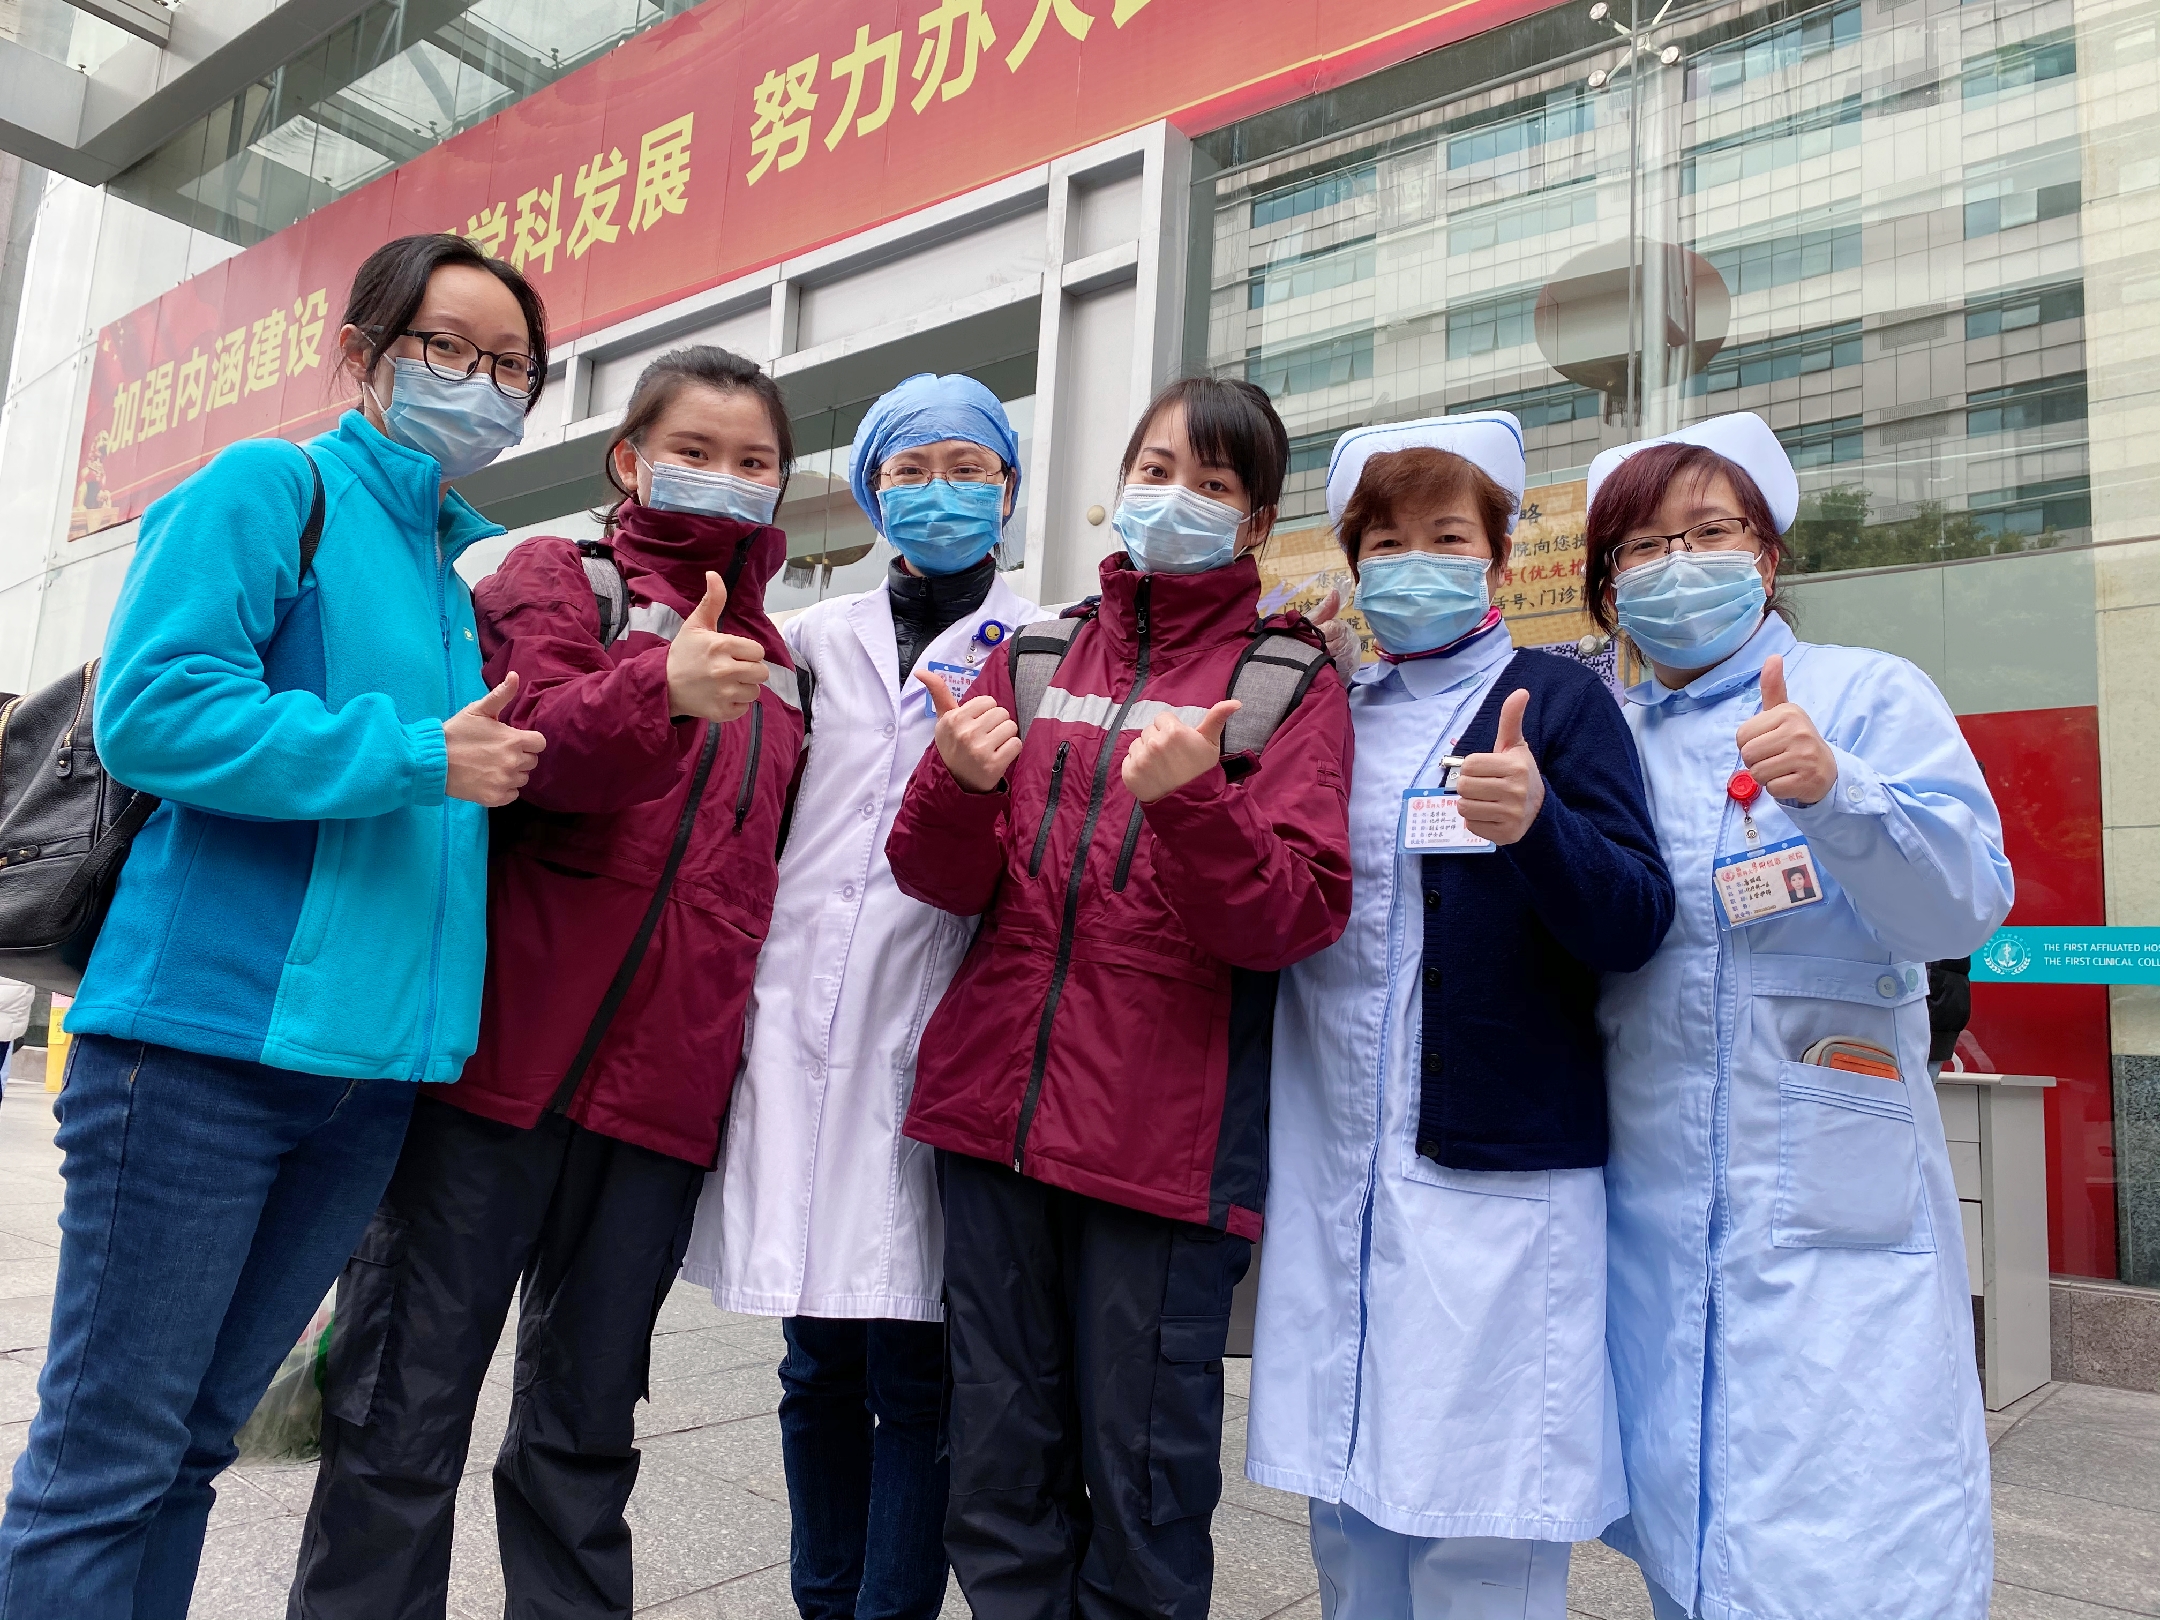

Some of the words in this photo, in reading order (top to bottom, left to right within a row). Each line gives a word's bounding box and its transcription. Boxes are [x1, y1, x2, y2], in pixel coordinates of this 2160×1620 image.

[107, 288, 328, 455] 加强内涵建设
[443, 112, 694, 274] 学科发展
[745, 0, 1151, 187] 努力办人
[2043, 943, 2061, 952] THE
[2063, 943, 2088, 952] FIRST
[2090, 943, 2141, 952] AFFILIATED
[2044, 957, 2061, 966] THE
[2065, 957, 2090, 966] FIRST
[2092, 957, 2134, 967] CLINICAL
